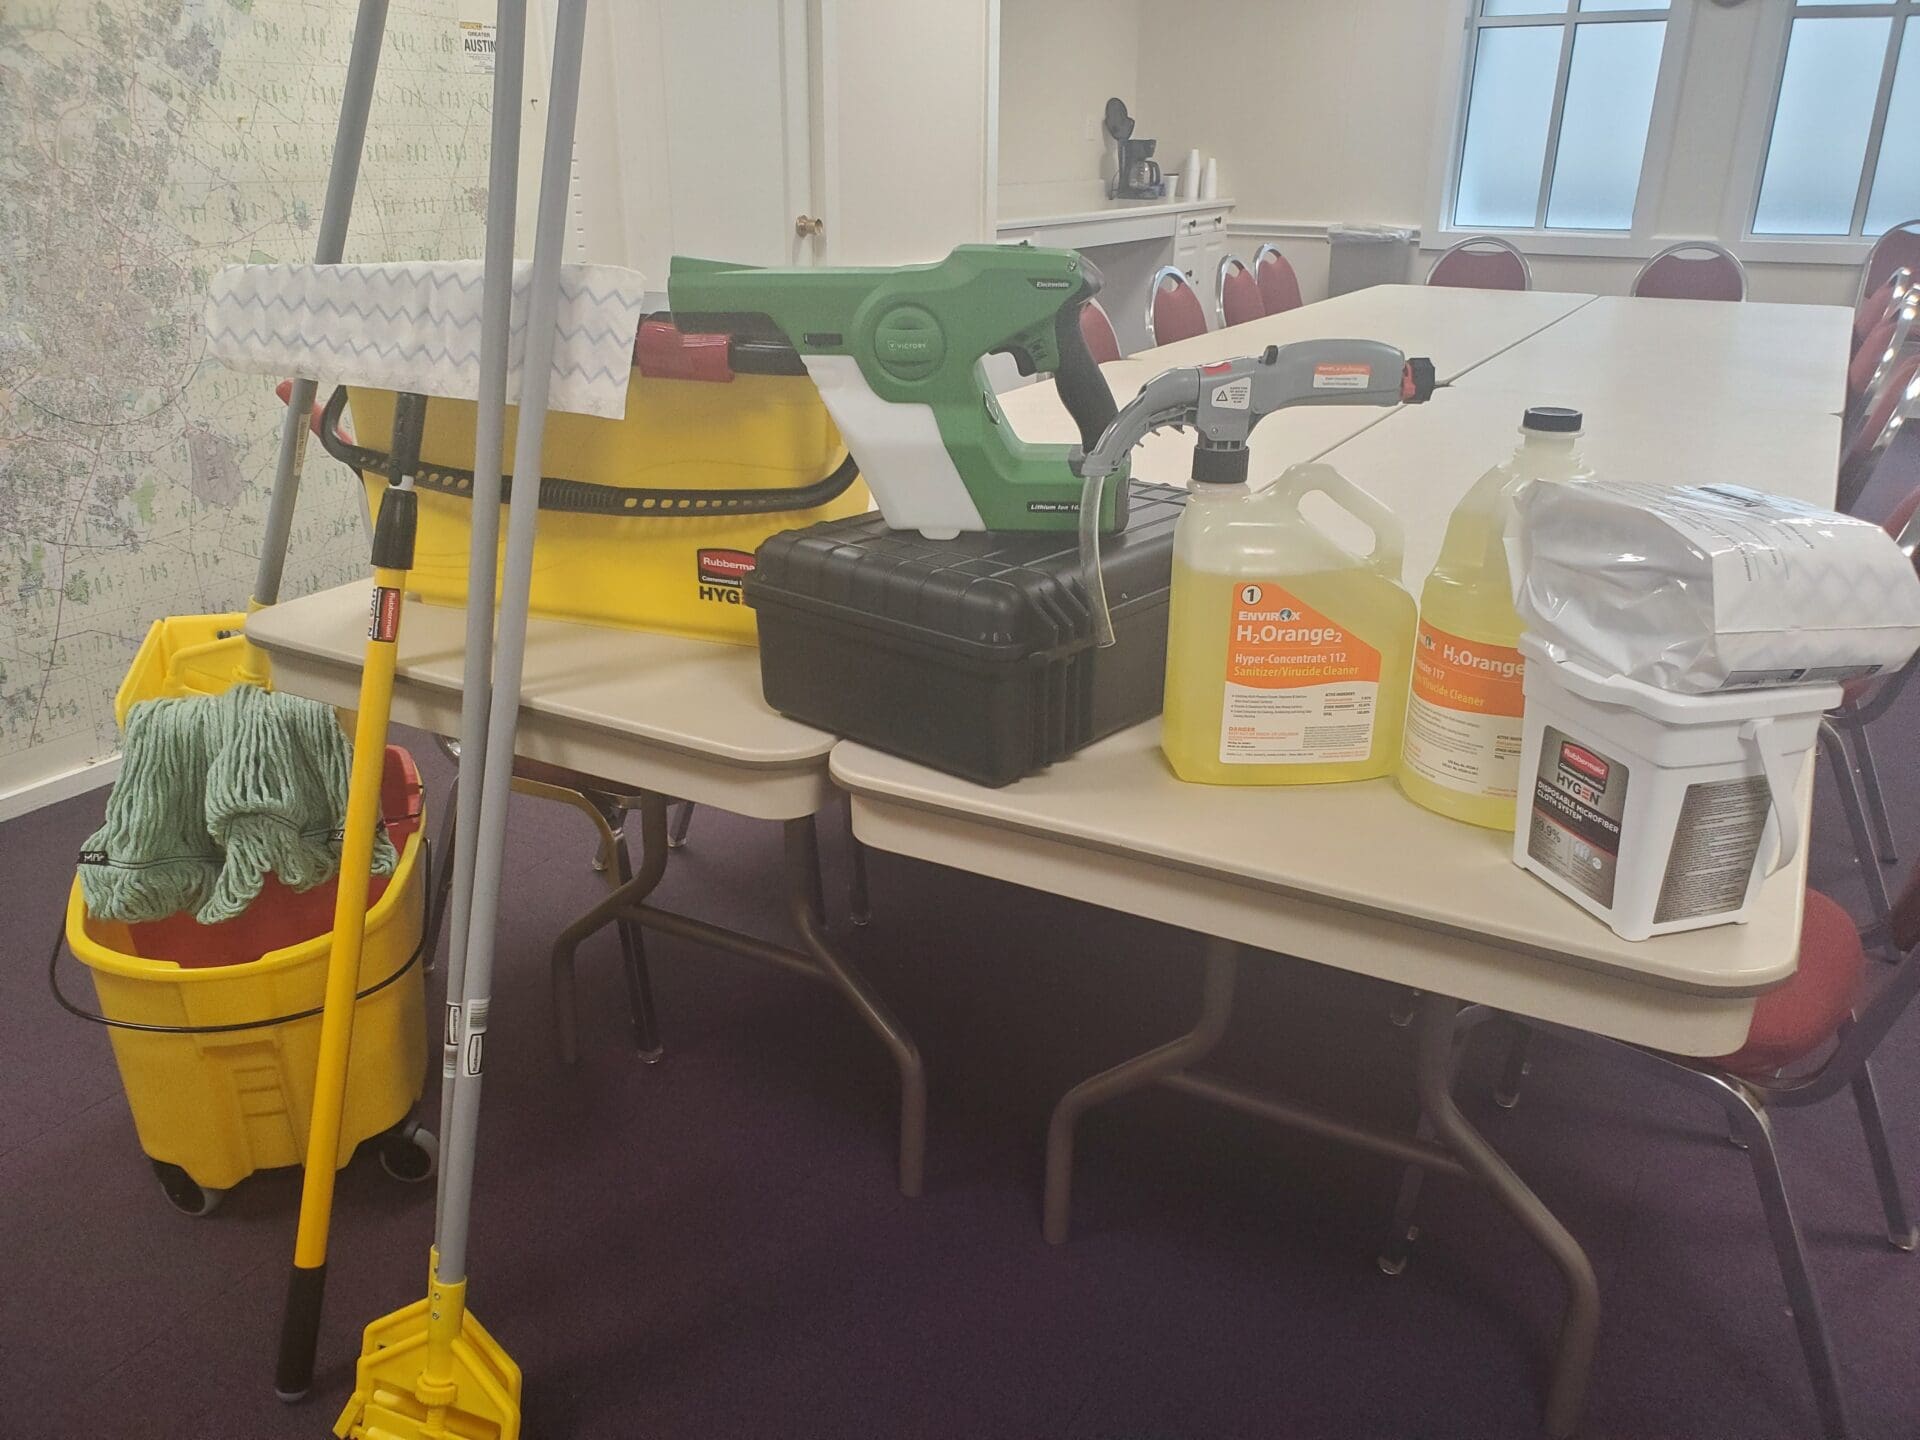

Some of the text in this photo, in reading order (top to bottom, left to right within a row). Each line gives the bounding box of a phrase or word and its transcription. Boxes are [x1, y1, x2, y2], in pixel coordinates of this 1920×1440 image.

[464, 38, 497, 53] AUSTIN
[699, 586, 744, 605] HYG
[1247, 588, 1256, 602] 1
[386, 592, 396, 638] Rubbermaid
[1235, 653, 1347, 666] Hyper-Concentrate 112
[1233, 665, 1360, 677] Sanitizer/Virucide Cleaner
[1449, 687, 1485, 707] Cleaner
[1564, 748, 1605, 774] Rubbermaid
[1536, 789, 1558, 807] CLOTH
[1557, 802, 1582, 822] SYSTEM
[1537, 780, 1576, 808] DISPOSABLE
[1576, 805, 1620, 834] MICROFIBER
